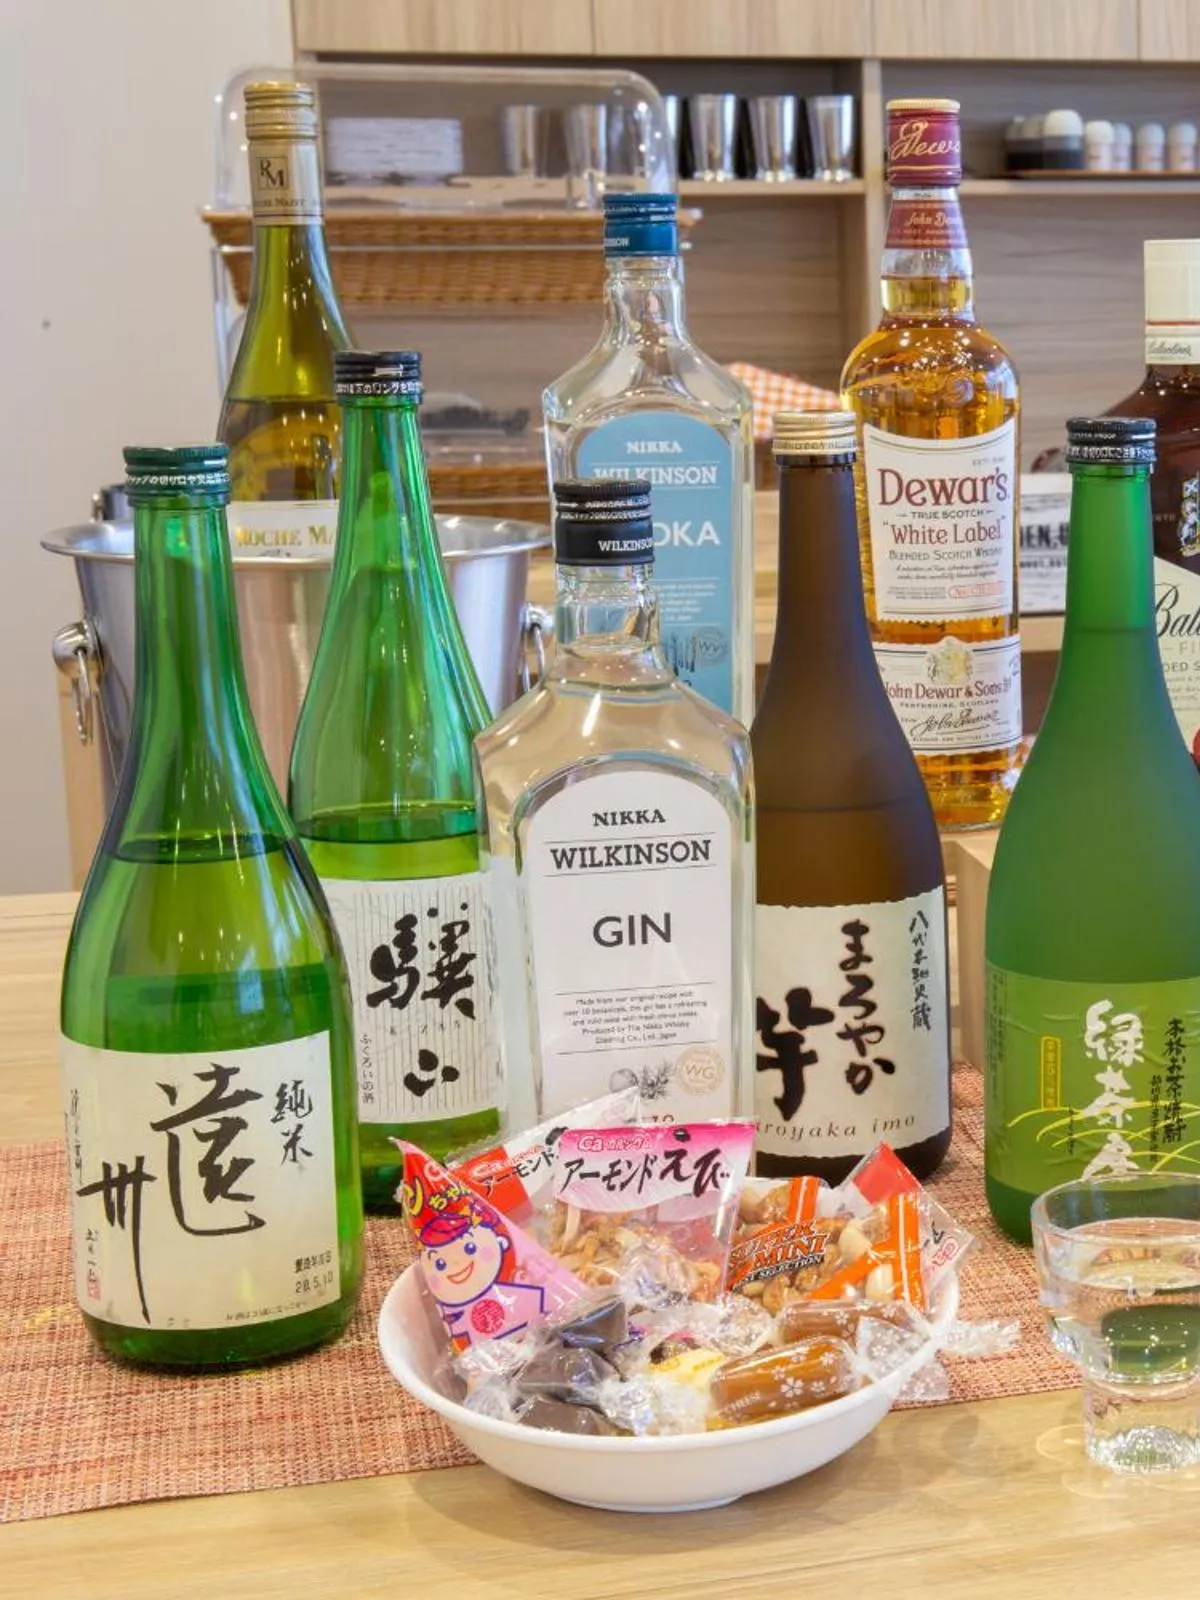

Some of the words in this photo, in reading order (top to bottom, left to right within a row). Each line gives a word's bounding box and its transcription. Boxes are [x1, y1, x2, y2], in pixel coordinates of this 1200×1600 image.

[626, 440, 683, 455] NIKKA
[877, 467, 1009, 506] Dewar's
[942, 509, 985, 520] SCOTCH
[653, 521, 721, 546] DKA
[885, 681, 912, 698] John
[915, 684, 960, 699] Dewar
[593, 810, 666, 826] NIKKA
[551, 840, 711, 870] WILKINSON
[593, 912, 672, 947] GIN
[836, 918, 896, 1095] まろやか
[270, 1080, 314, 1166] 純米
[756, 1120, 857, 1140] royaka
[872, 1114, 916, 1134] imo
